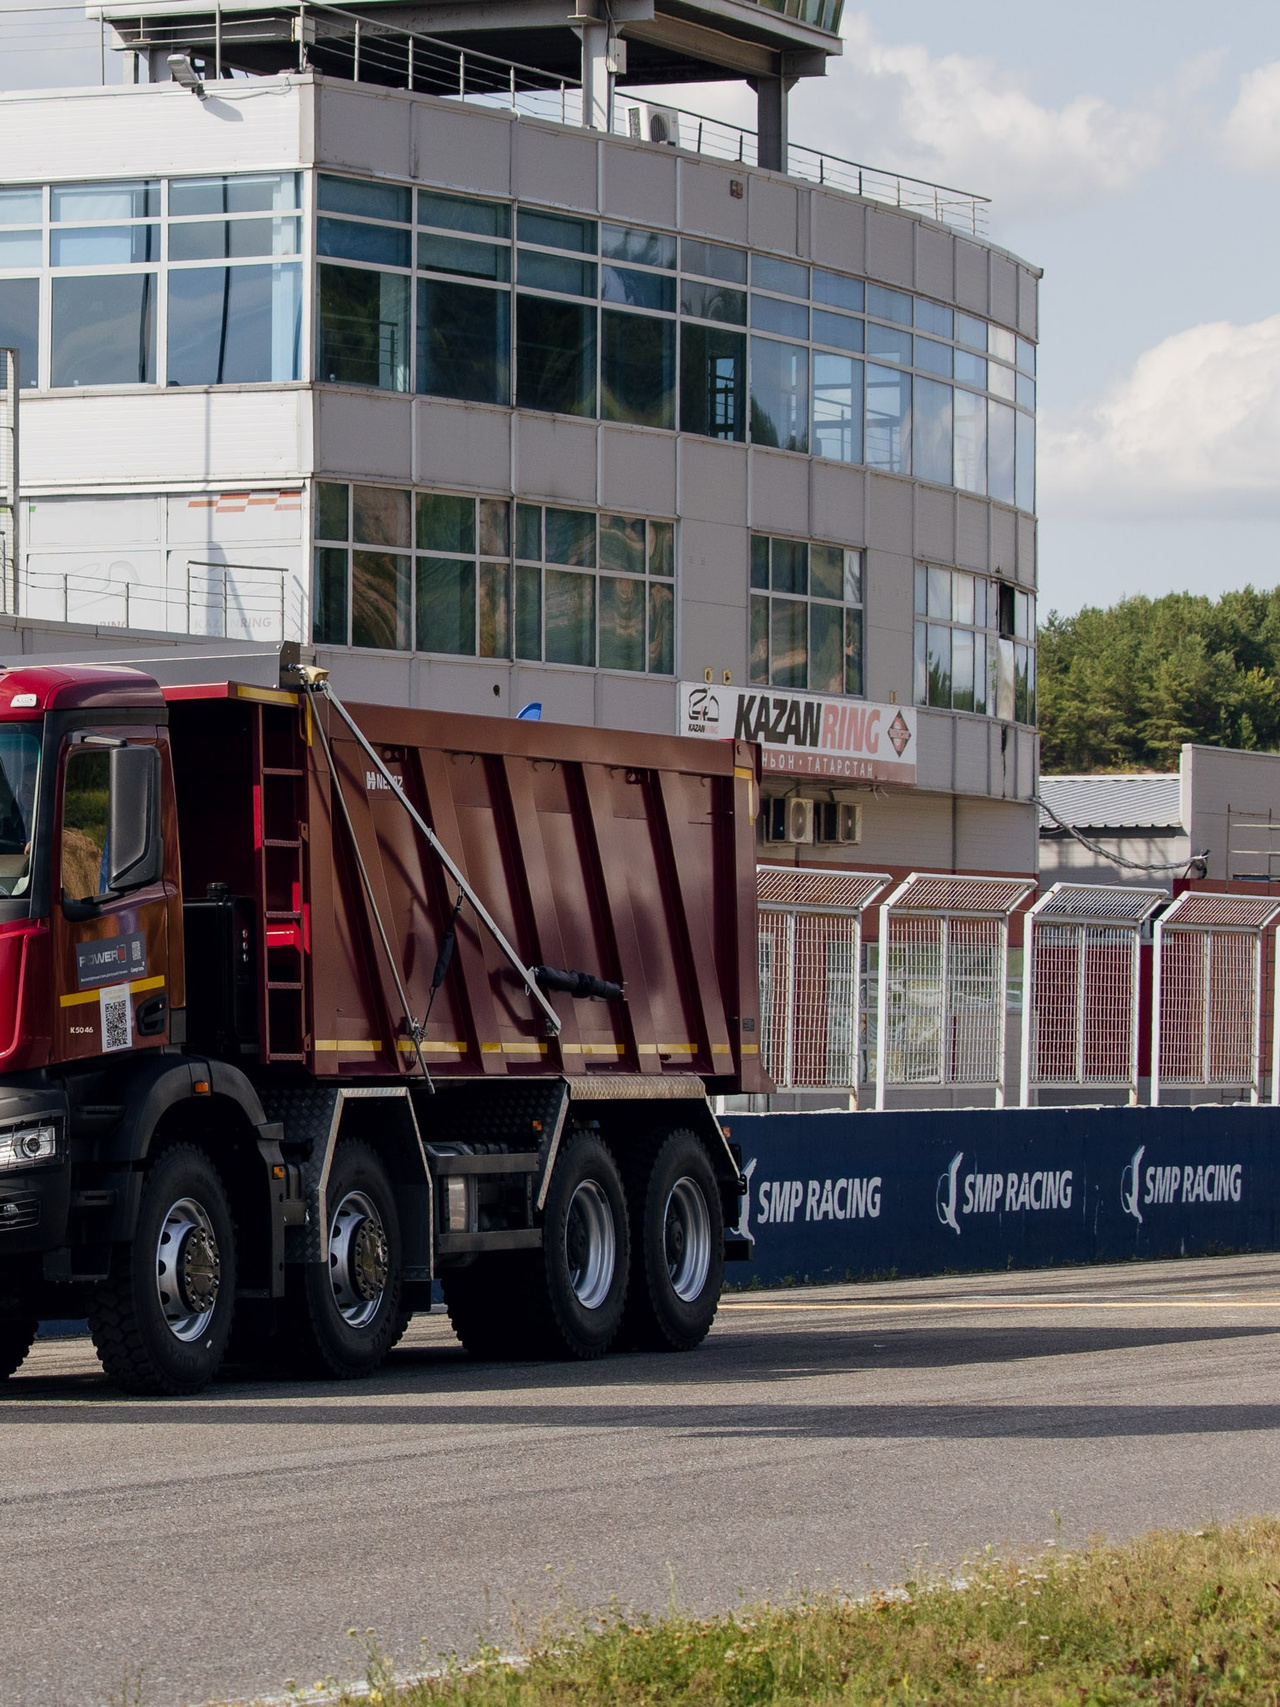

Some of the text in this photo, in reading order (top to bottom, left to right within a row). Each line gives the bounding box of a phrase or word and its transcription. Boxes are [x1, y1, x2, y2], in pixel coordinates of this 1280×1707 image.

[734, 694, 882, 755] KAZANRING
[762, 752, 873, 778] НЬОН ТАТАРСТАН
[757, 1177, 882, 1224] SMP RACING
[962, 1170, 1073, 1214] SMP RACING
[1144, 1164, 1242, 1204] SMP RACING
